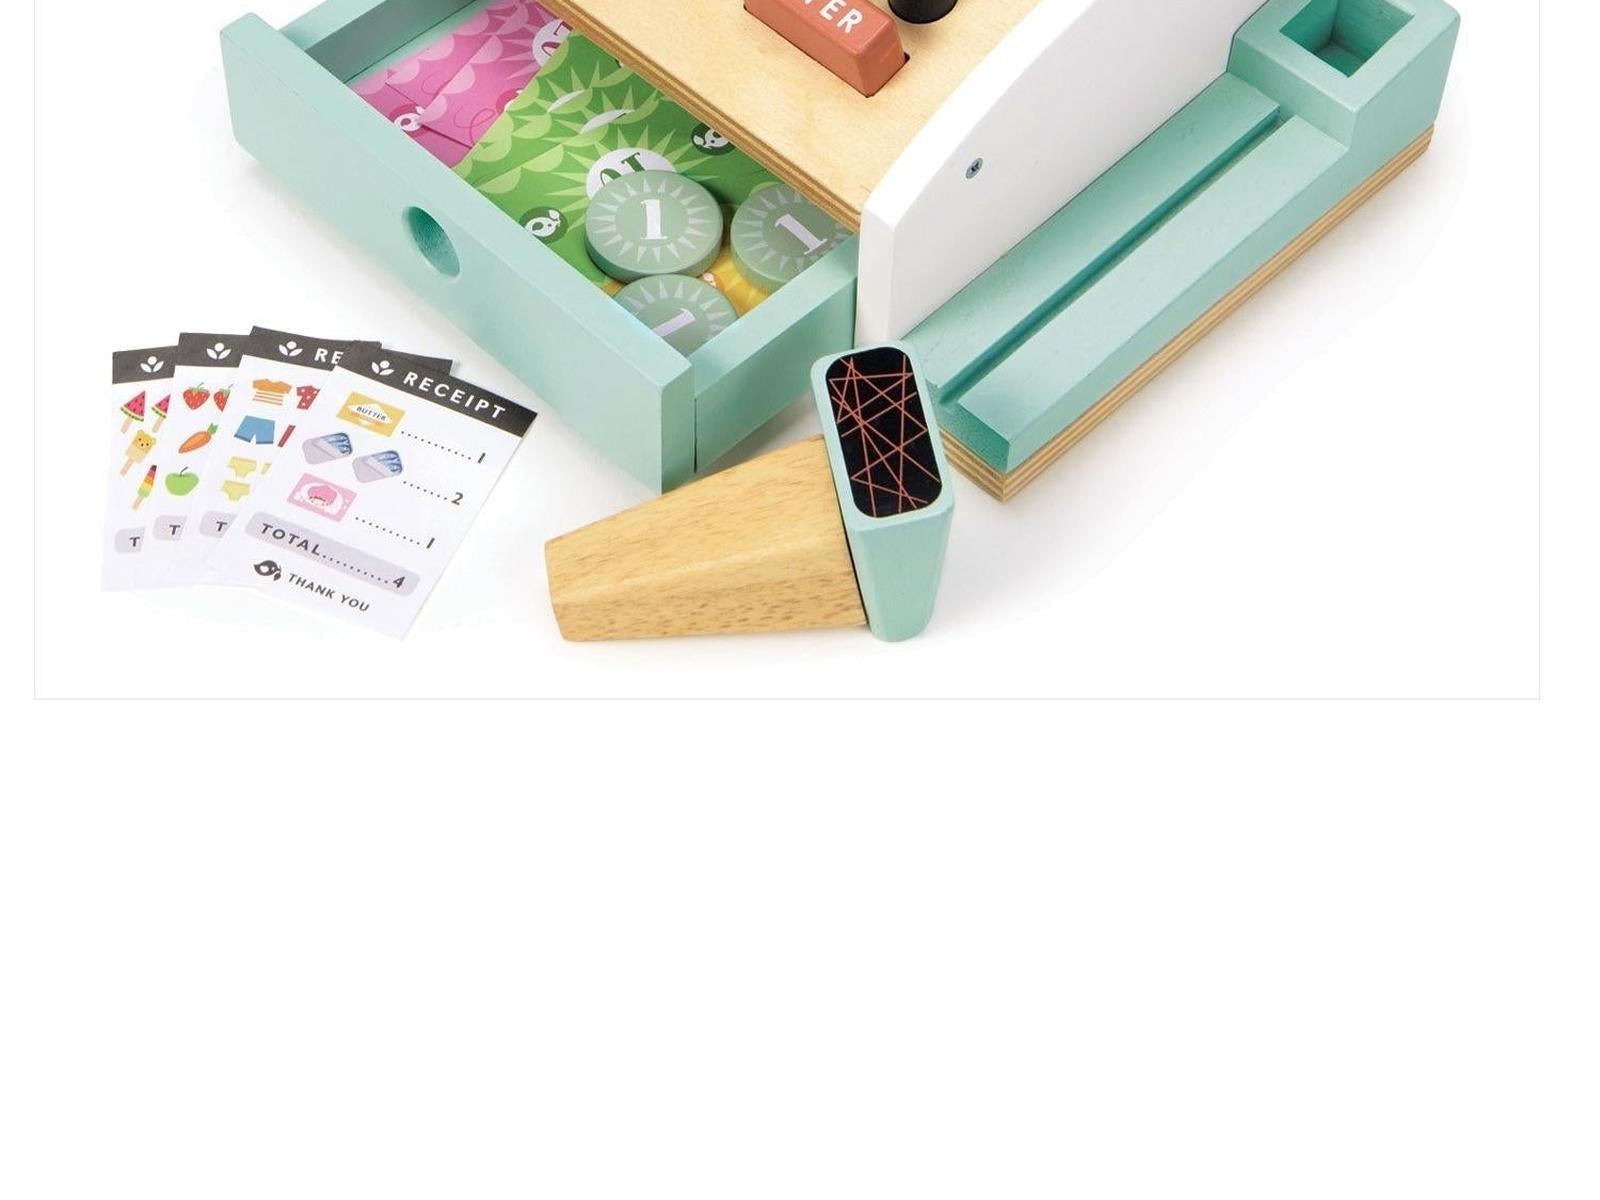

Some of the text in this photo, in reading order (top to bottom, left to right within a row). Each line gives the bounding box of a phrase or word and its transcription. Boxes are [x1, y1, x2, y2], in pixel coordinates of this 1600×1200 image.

[640, 198, 668, 241] 1
[774, 212, 828, 256] 1
[403, 371, 506, 420] RECEIPT
[129, 536, 141, 548] T
[169, 524, 181, 536] T
[216, 520, 228, 532] T
[288, 573, 370, 612] THANK YOU
